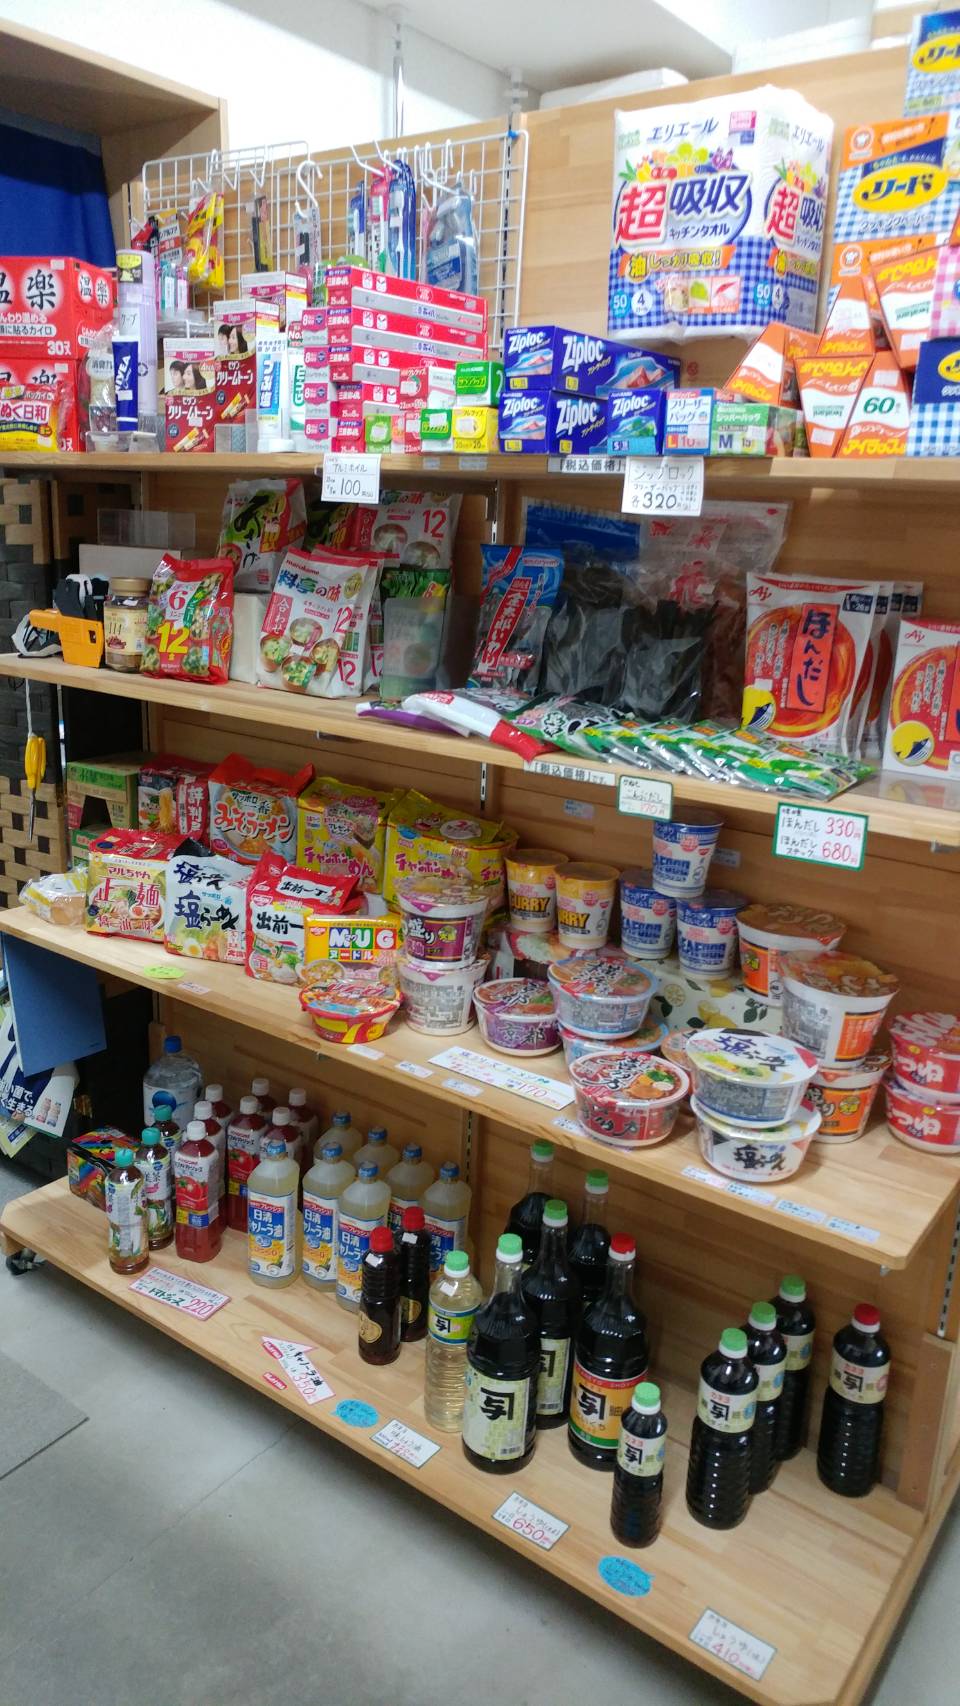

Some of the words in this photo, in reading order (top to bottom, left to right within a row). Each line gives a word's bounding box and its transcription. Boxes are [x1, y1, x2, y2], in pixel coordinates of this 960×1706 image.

[651, 117, 719, 142] エリエール
[861, 174, 933, 201] リード
[616, 184, 667, 241] 超
[670, 176, 748, 215] 吸収
[669, 223, 730, 238] キッチンタオル
[613, 293, 628, 308] 50
[638, 293, 646, 305] 4
[508, 331, 544, 353] Ziploc
[562, 335, 603, 373] Ziploc
[115, 355, 131, 391] NIVEA
[259, 359, 275, 408] つぶ塩
[503, 398, 538, 419] Ziploc
[611, 395, 649, 419] Ziploc
[864, 397, 895, 414] 60
[555, 399, 598, 436] Ziploc
[670, 411, 696, 422] バッグ
[667, 433, 676, 448] L
[719, 434, 734, 448] M
[634, 464, 695, 480] ジップロック
[341, 478, 361, 495] 100
[643, 491, 677, 509] 320
[423, 508, 447, 539] 12
[169, 590, 188, 610] 6
[332, 606, 352, 633] 12
[157, 620, 191, 654] 12
[799, 609, 832, 706] ほんだし
[337, 658, 355, 686] 12
[214, 802, 295, 842] みそラーメン
[782, 817, 820, 832] ほんだし
[780, 836, 818, 848] ほんだし
[108, 866, 151, 880] マルちゃん
[280, 881, 328, 897] 出前一丁
[174, 890, 239, 930] 塩らーめん
[500, 1022, 546, 1048] 京都
[253, 1209, 272, 1222] 日清
[304, 1210, 321, 1223] 日清
[341, 1232, 360, 1247] 日清
[183, 1298, 214, 1316] 220
[512, 1516, 545, 1541] 650
[713, 1642, 740, 1665] 410
